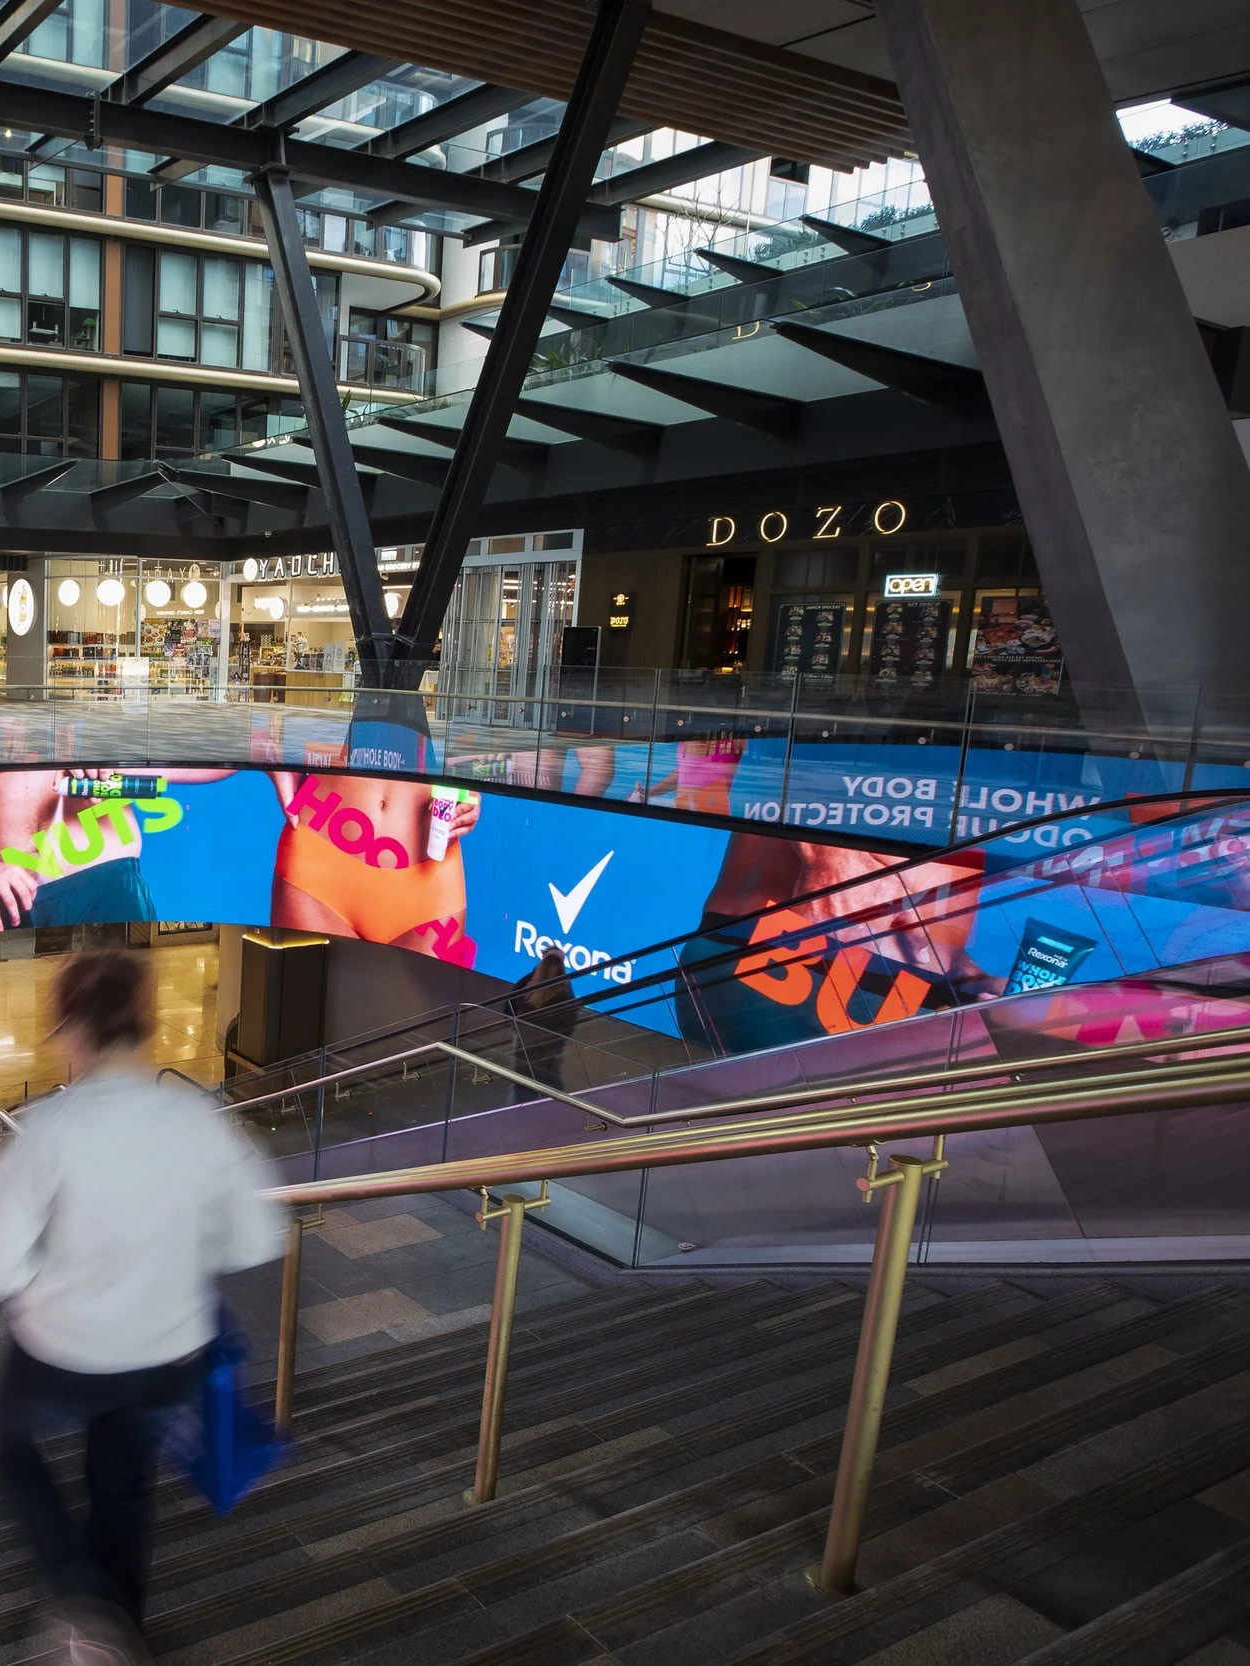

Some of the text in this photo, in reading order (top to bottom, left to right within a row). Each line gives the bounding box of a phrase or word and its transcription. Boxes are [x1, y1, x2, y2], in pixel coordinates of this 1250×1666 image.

[706, 500, 906, 546] DOZO
[260, 551, 342, 580] YAOCH
[0, 795, 184, 879] NUTS
[515, 919, 635, 985] Rexona
[1027, 947, 1069, 969] Rexona
